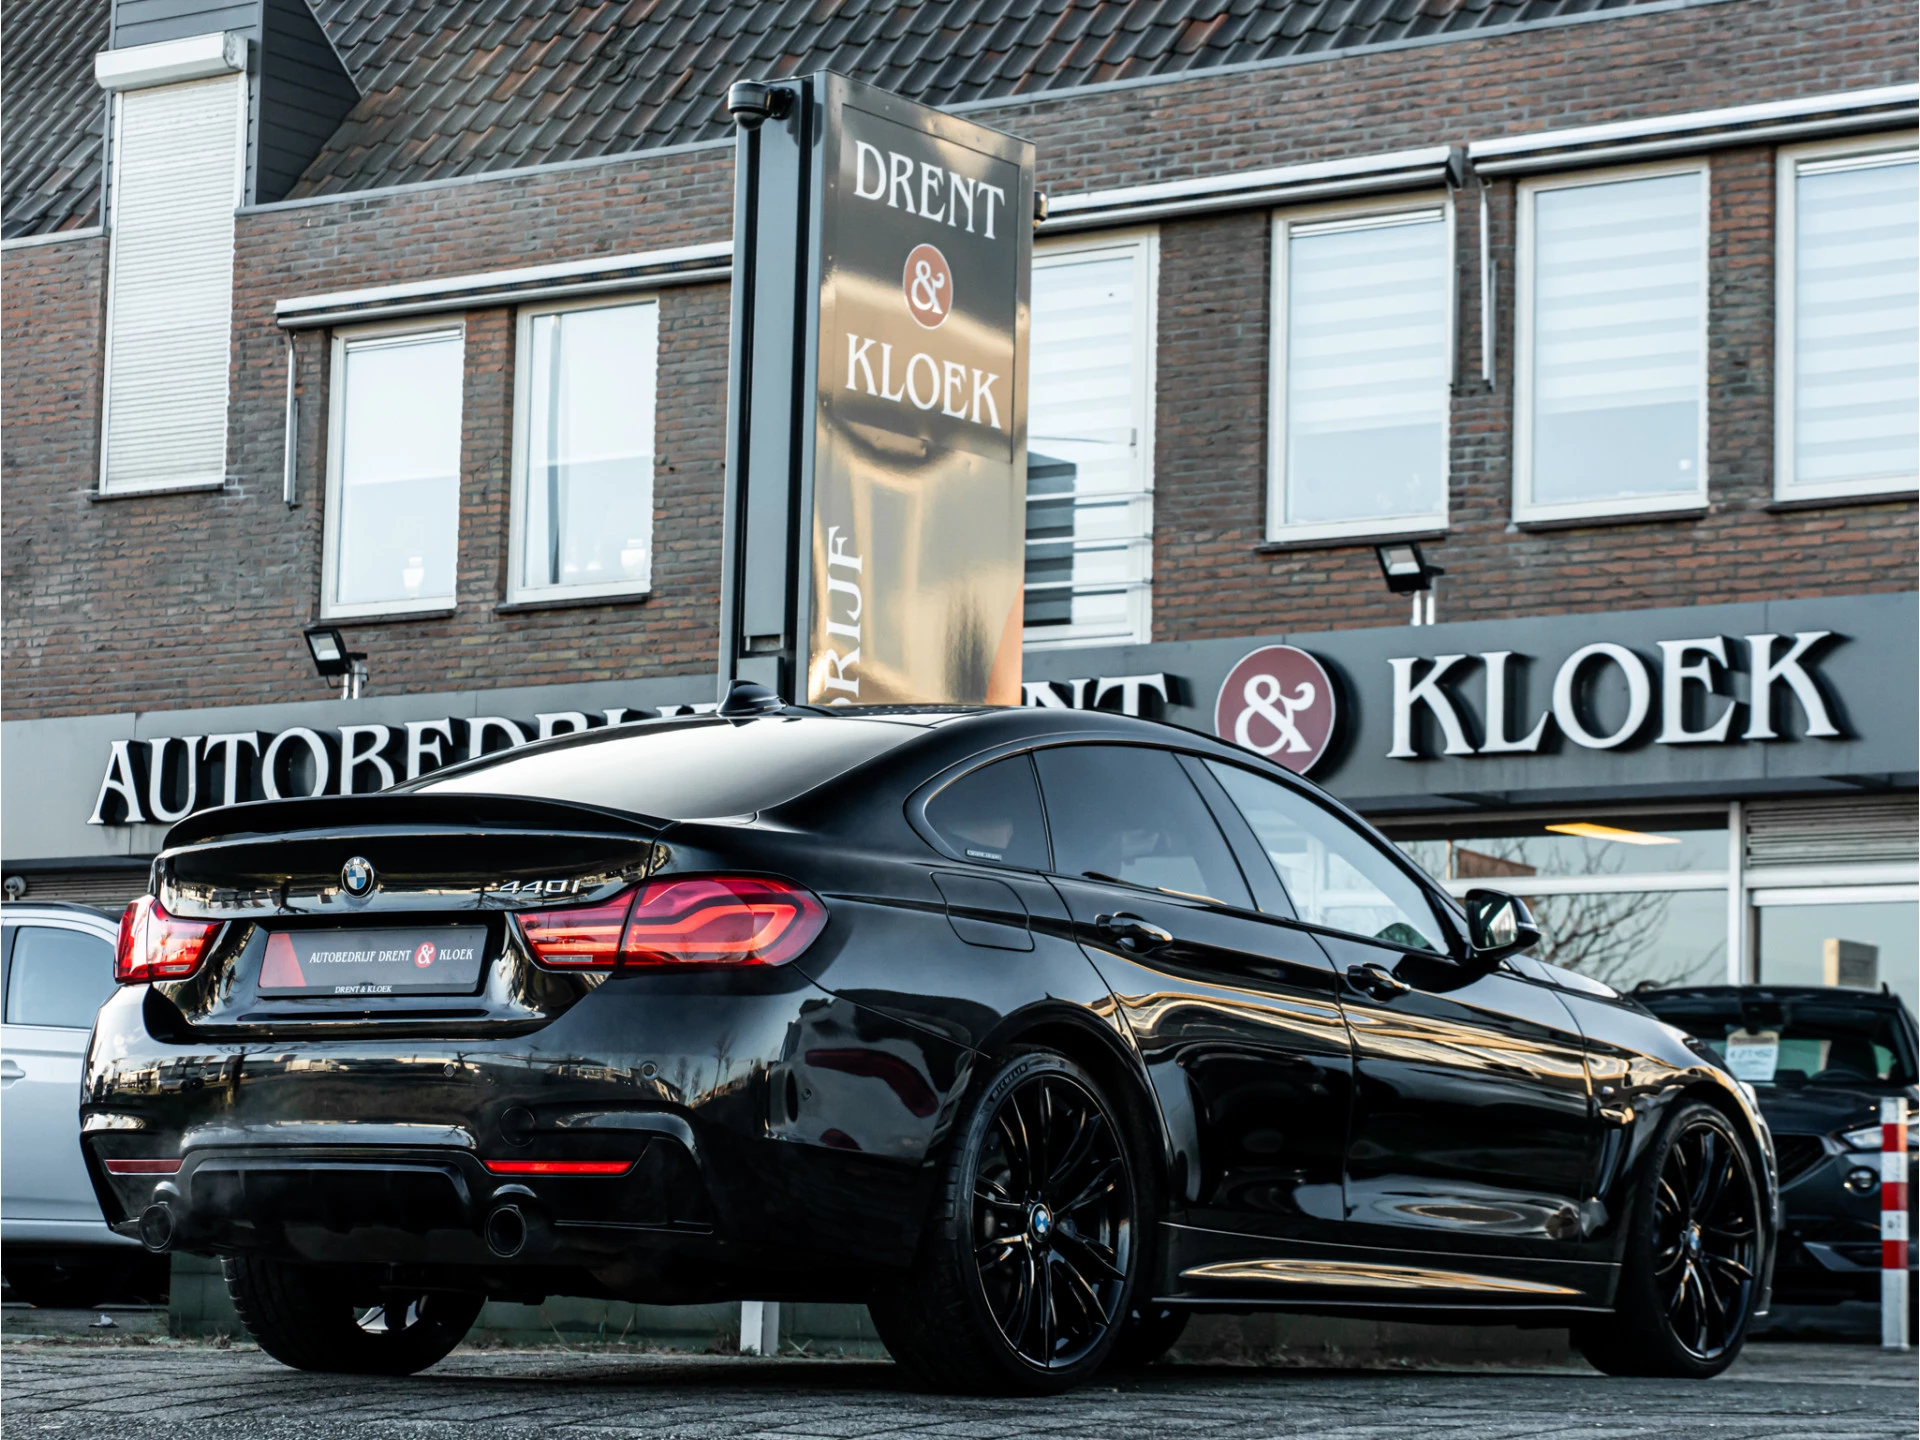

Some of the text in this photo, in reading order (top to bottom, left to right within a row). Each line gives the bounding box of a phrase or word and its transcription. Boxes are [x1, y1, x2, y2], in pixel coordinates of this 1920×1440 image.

[853, 140, 1005, 240] DRENT
[911, 260, 945, 315] &
[845, 333, 1002, 430] KLOEK
[1234, 674, 1316, 756] &
[1386, 630, 1840, 758] KLOEK
[309, 944, 474, 965] AUTOBEDRIJF DRENT & KLOEK
[334, 986, 359, 994] DRENT
[367, 985, 392, 993] KLOEK
[991, 1064, 1028, 1099] MICHELIN
